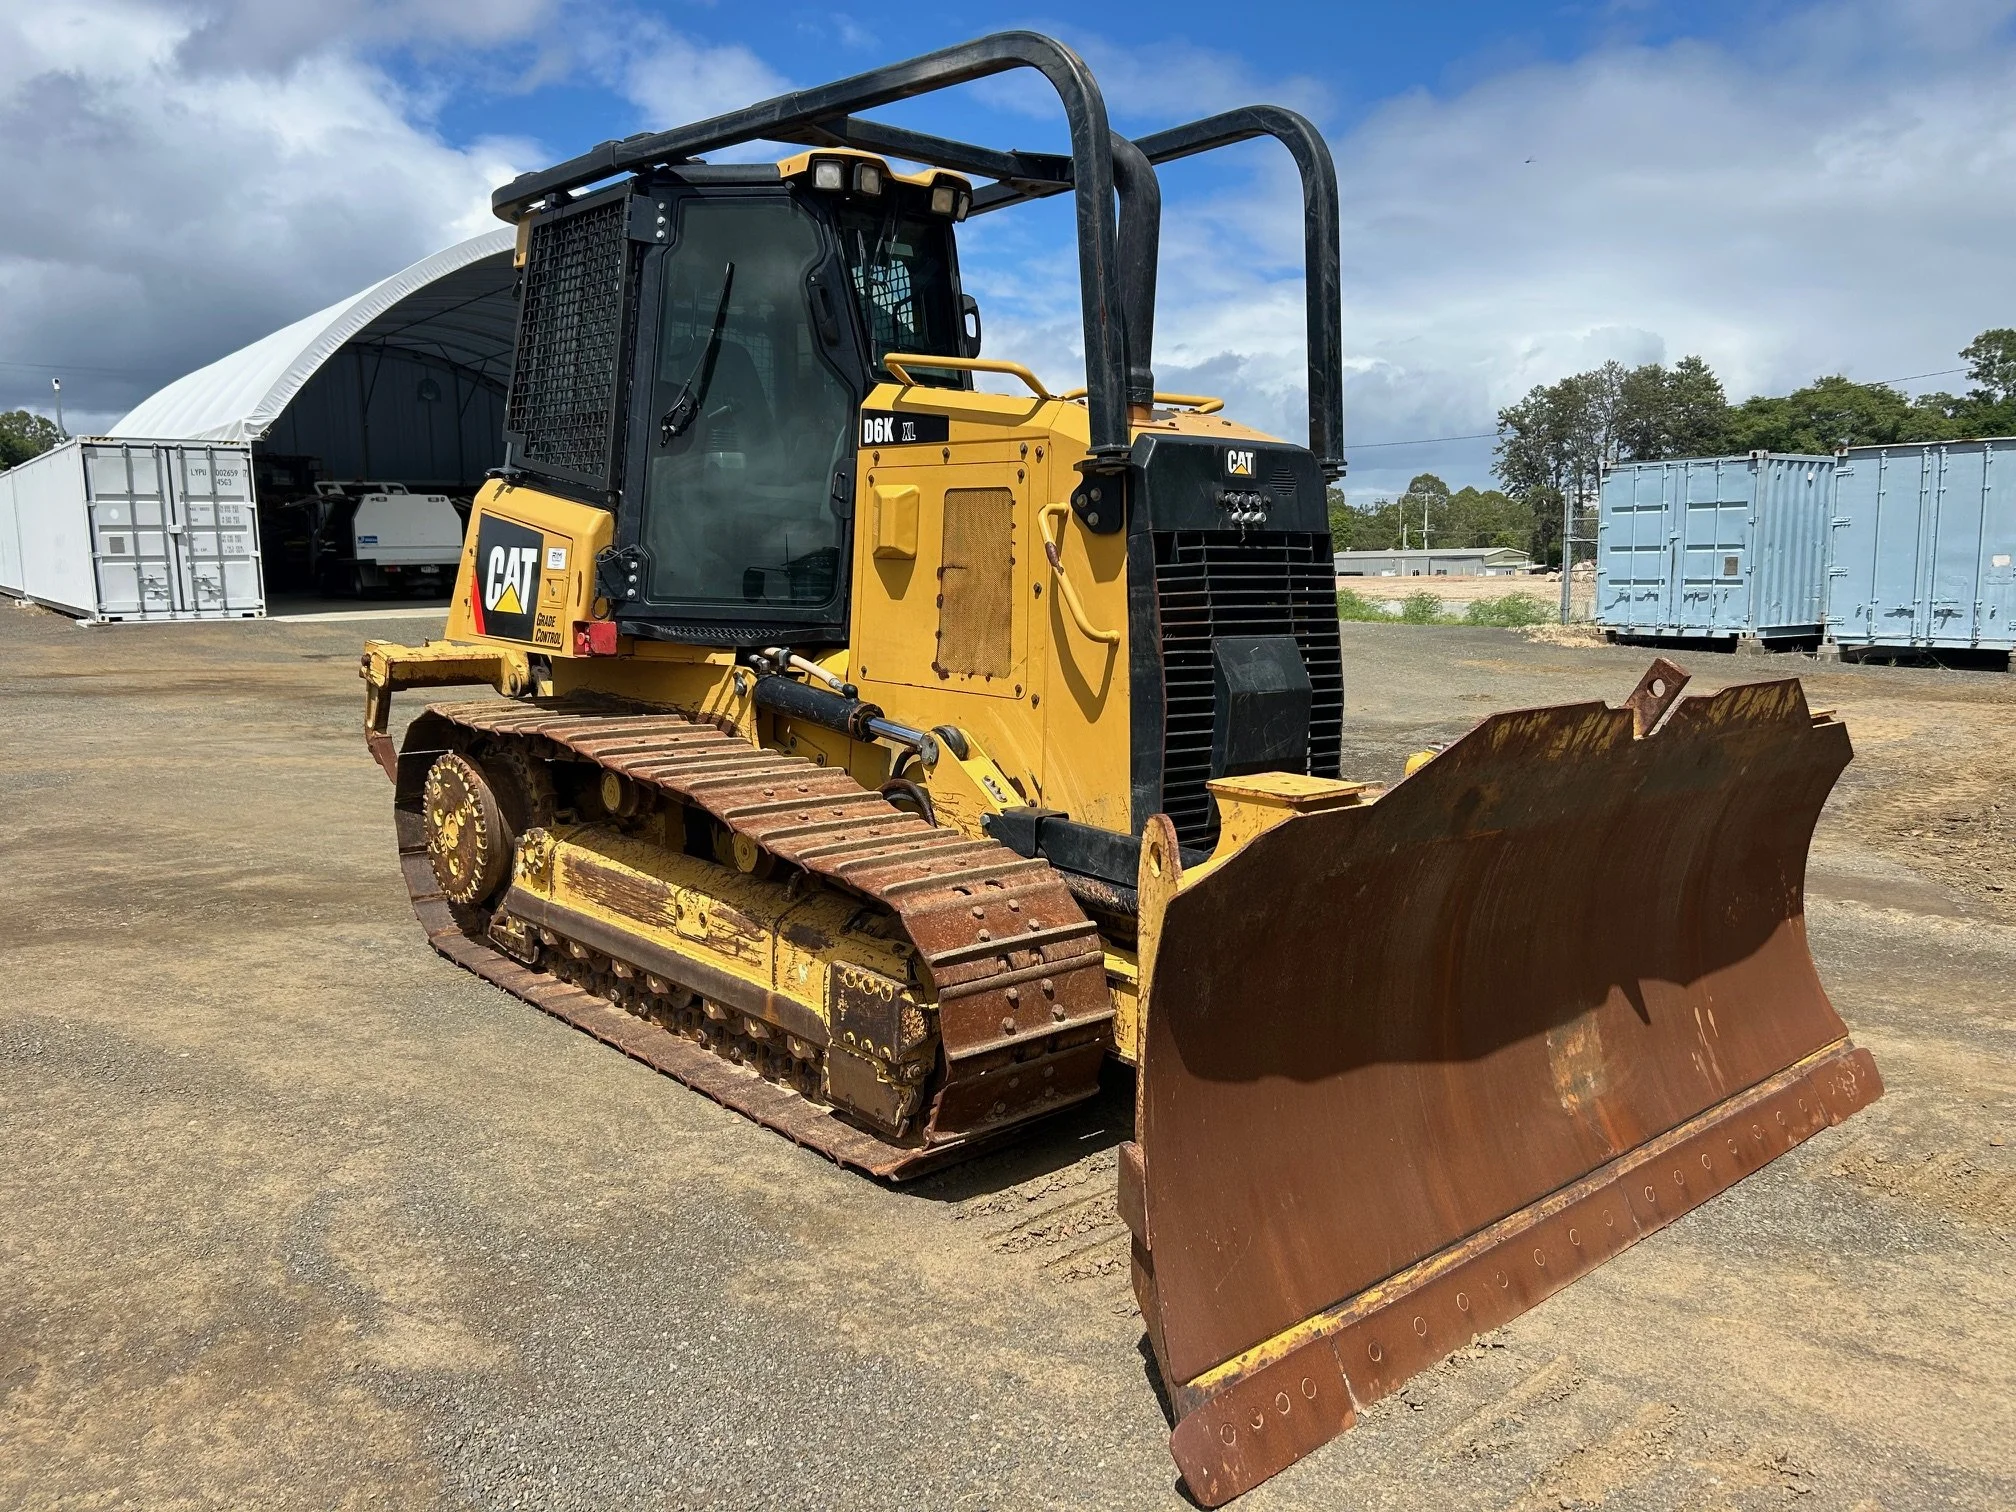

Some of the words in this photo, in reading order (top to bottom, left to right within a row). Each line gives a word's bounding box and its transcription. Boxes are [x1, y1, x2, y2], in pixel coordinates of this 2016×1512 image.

[864, 417, 894, 444] D6K
[902, 421, 917, 442] XL
[1227, 449, 1254, 475] CAT
[485, 545, 538, 615] CAT
[536, 612, 557, 628] GRADE
[535, 628, 562, 645] CONTROL
